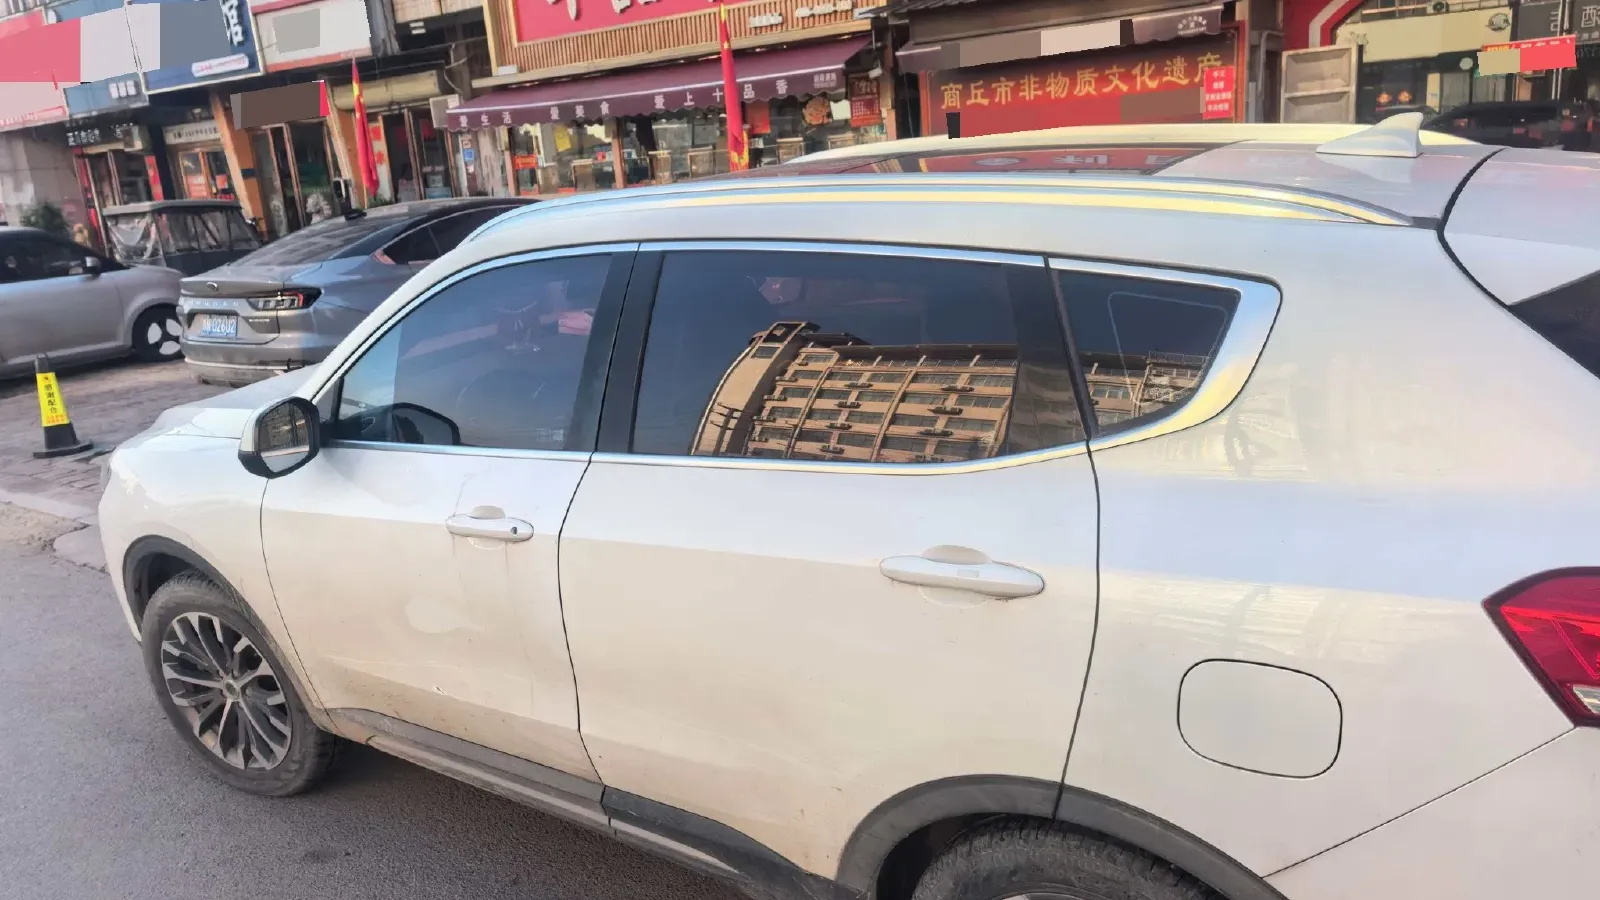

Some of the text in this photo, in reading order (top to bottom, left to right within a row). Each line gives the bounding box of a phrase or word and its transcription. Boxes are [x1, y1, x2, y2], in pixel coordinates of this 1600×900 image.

[941, 52, 1222, 109] 商丘市非物质文化遗产
